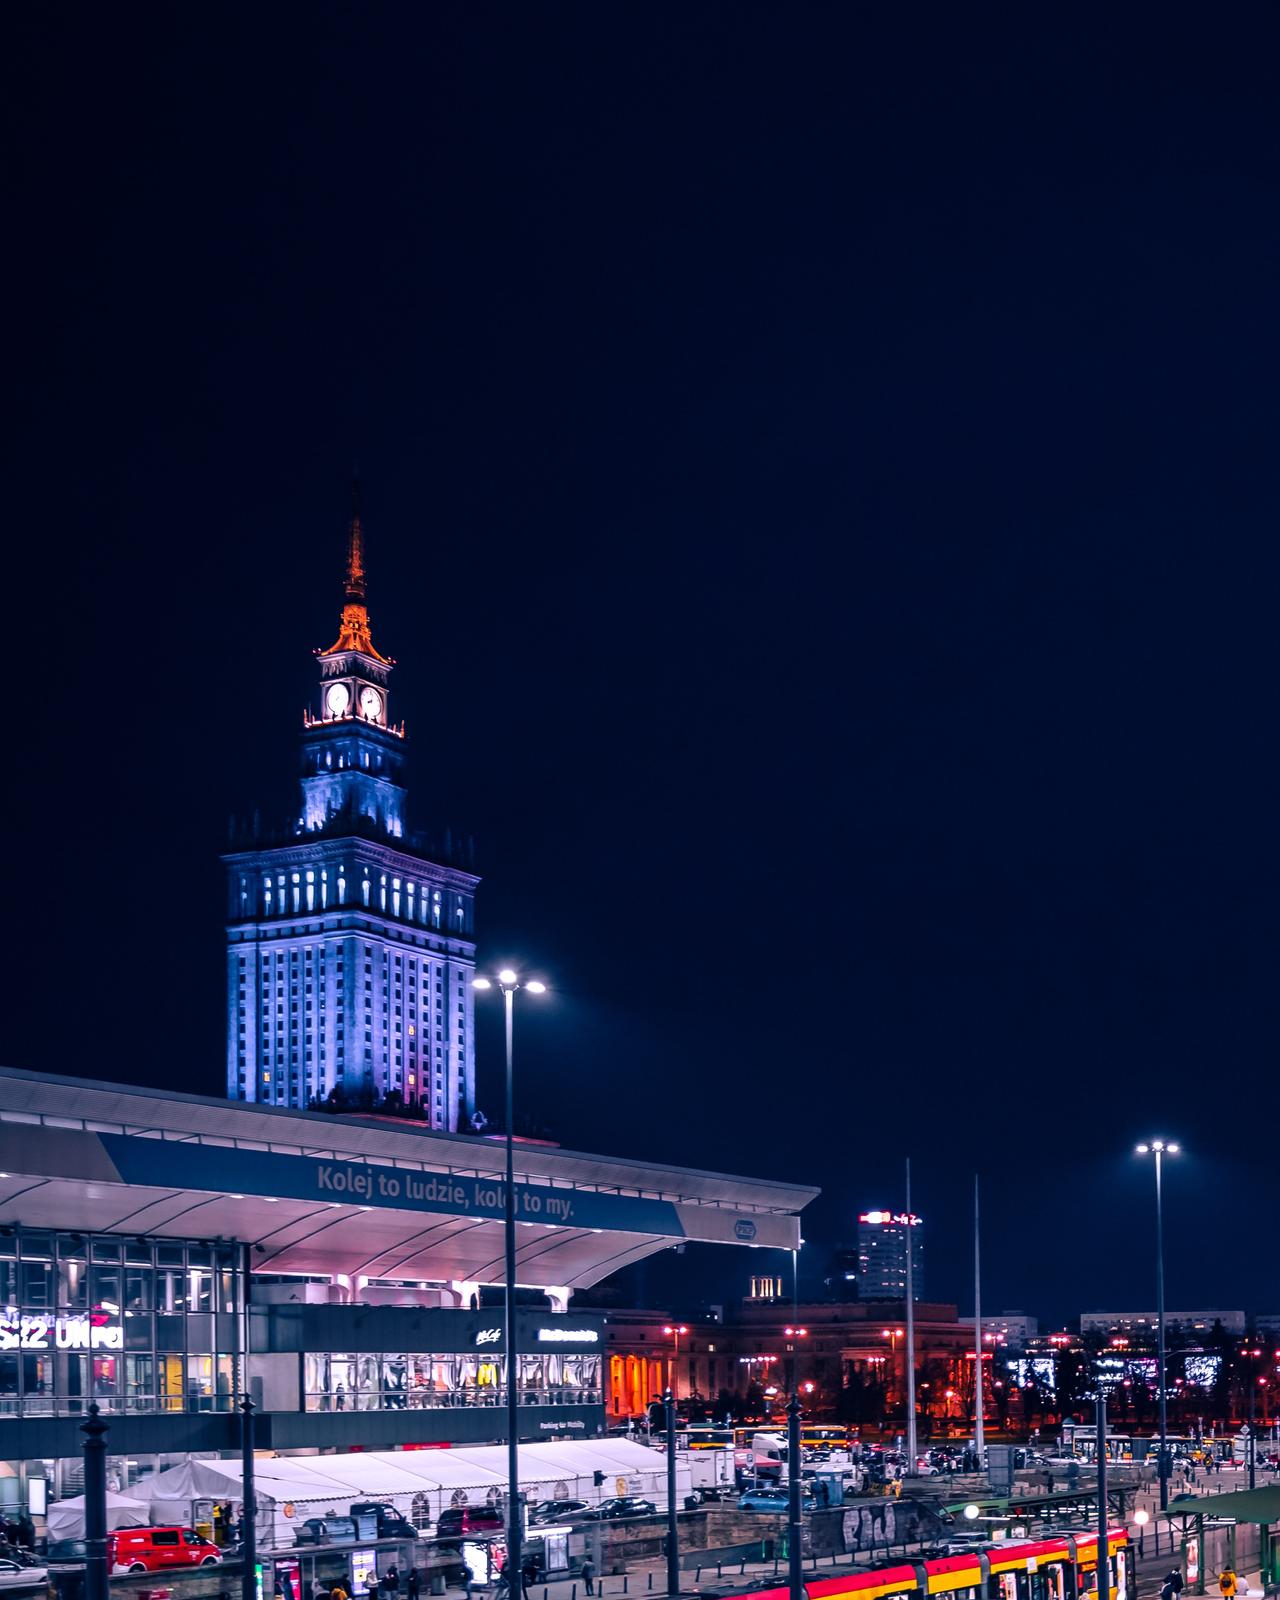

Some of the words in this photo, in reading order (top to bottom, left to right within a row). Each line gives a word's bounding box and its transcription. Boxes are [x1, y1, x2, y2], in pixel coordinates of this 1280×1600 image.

[318, 1166, 372, 1199] Kolej
[378, 1174, 400, 1197] to
[406, 1175, 469, 1209] ludzie,
[475, 1184, 519, 1214] kolj
[523, 1191, 542, 1213] to
[546, 1197, 575, 1221] my.
